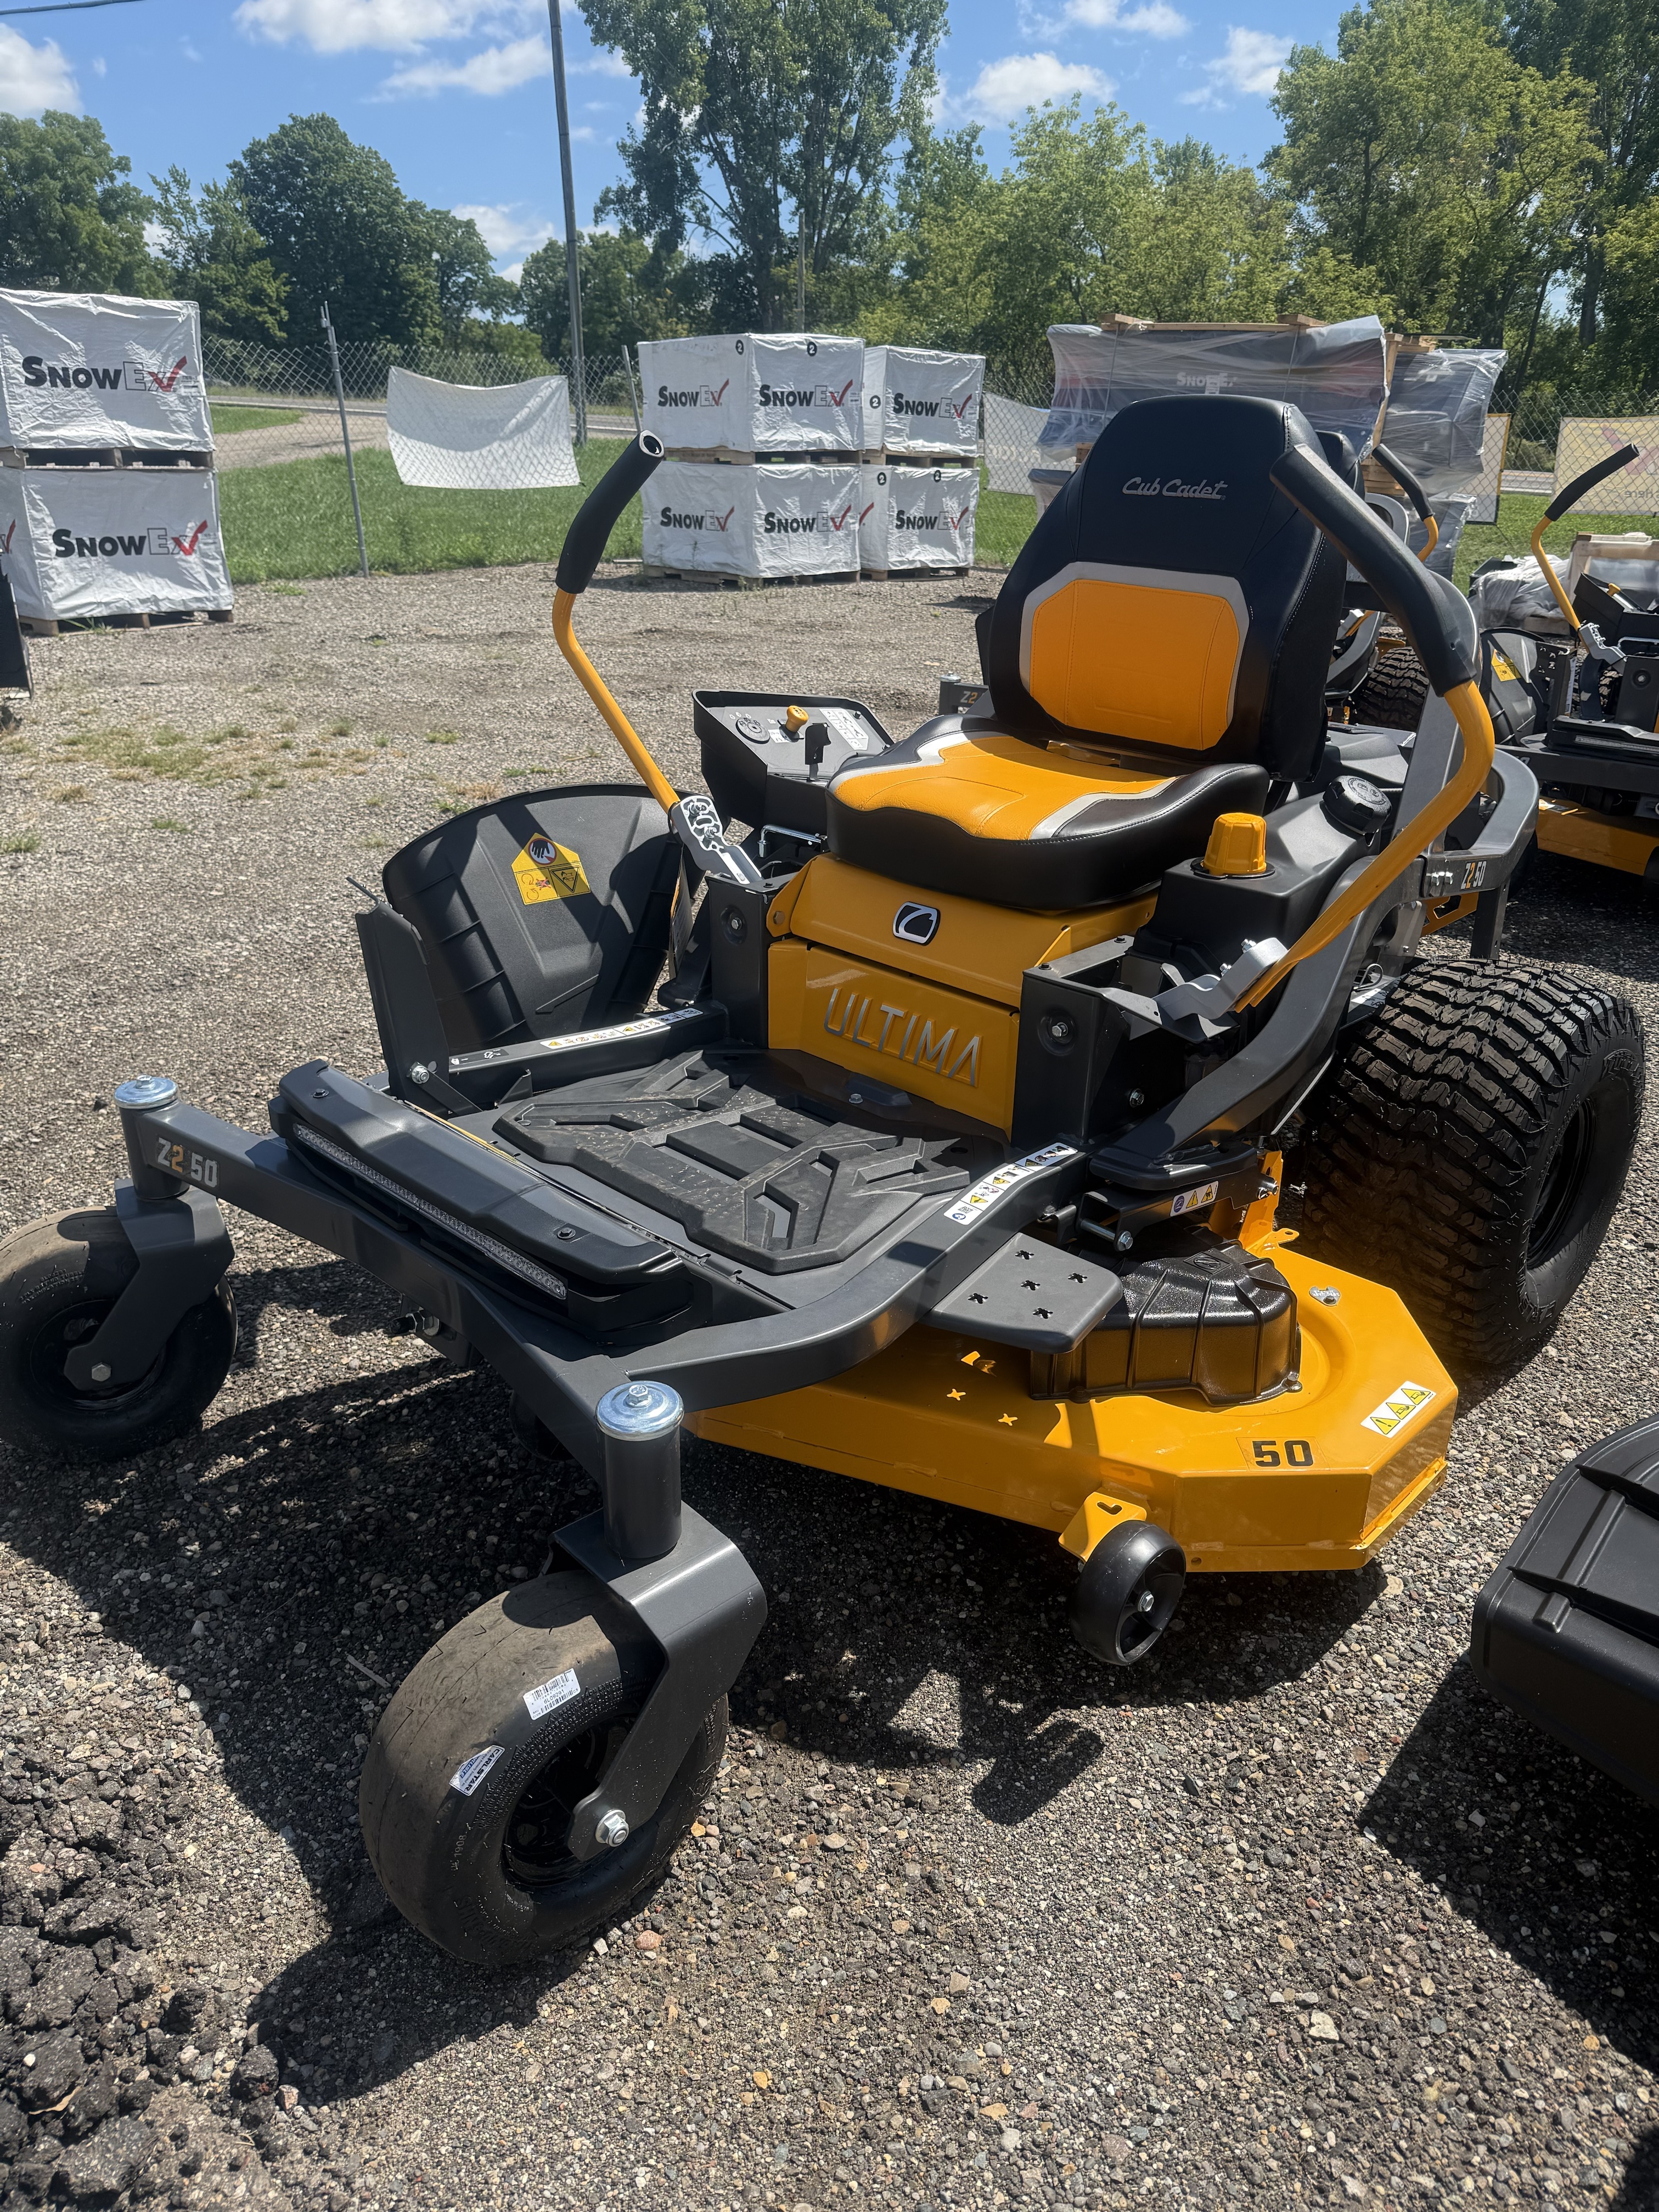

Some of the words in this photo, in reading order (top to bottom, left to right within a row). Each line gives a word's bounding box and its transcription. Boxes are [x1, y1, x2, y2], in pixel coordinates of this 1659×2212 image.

[1122, 477, 1161, 496] Cub
[1162, 479, 1228, 499] Cadet
[824, 988, 982, 1087] ULTIMA
[1252, 1440, 1314, 1467] 50
[464, 1748, 500, 1791] CARLSTAR
[454, 1834, 466, 1856] 1908
